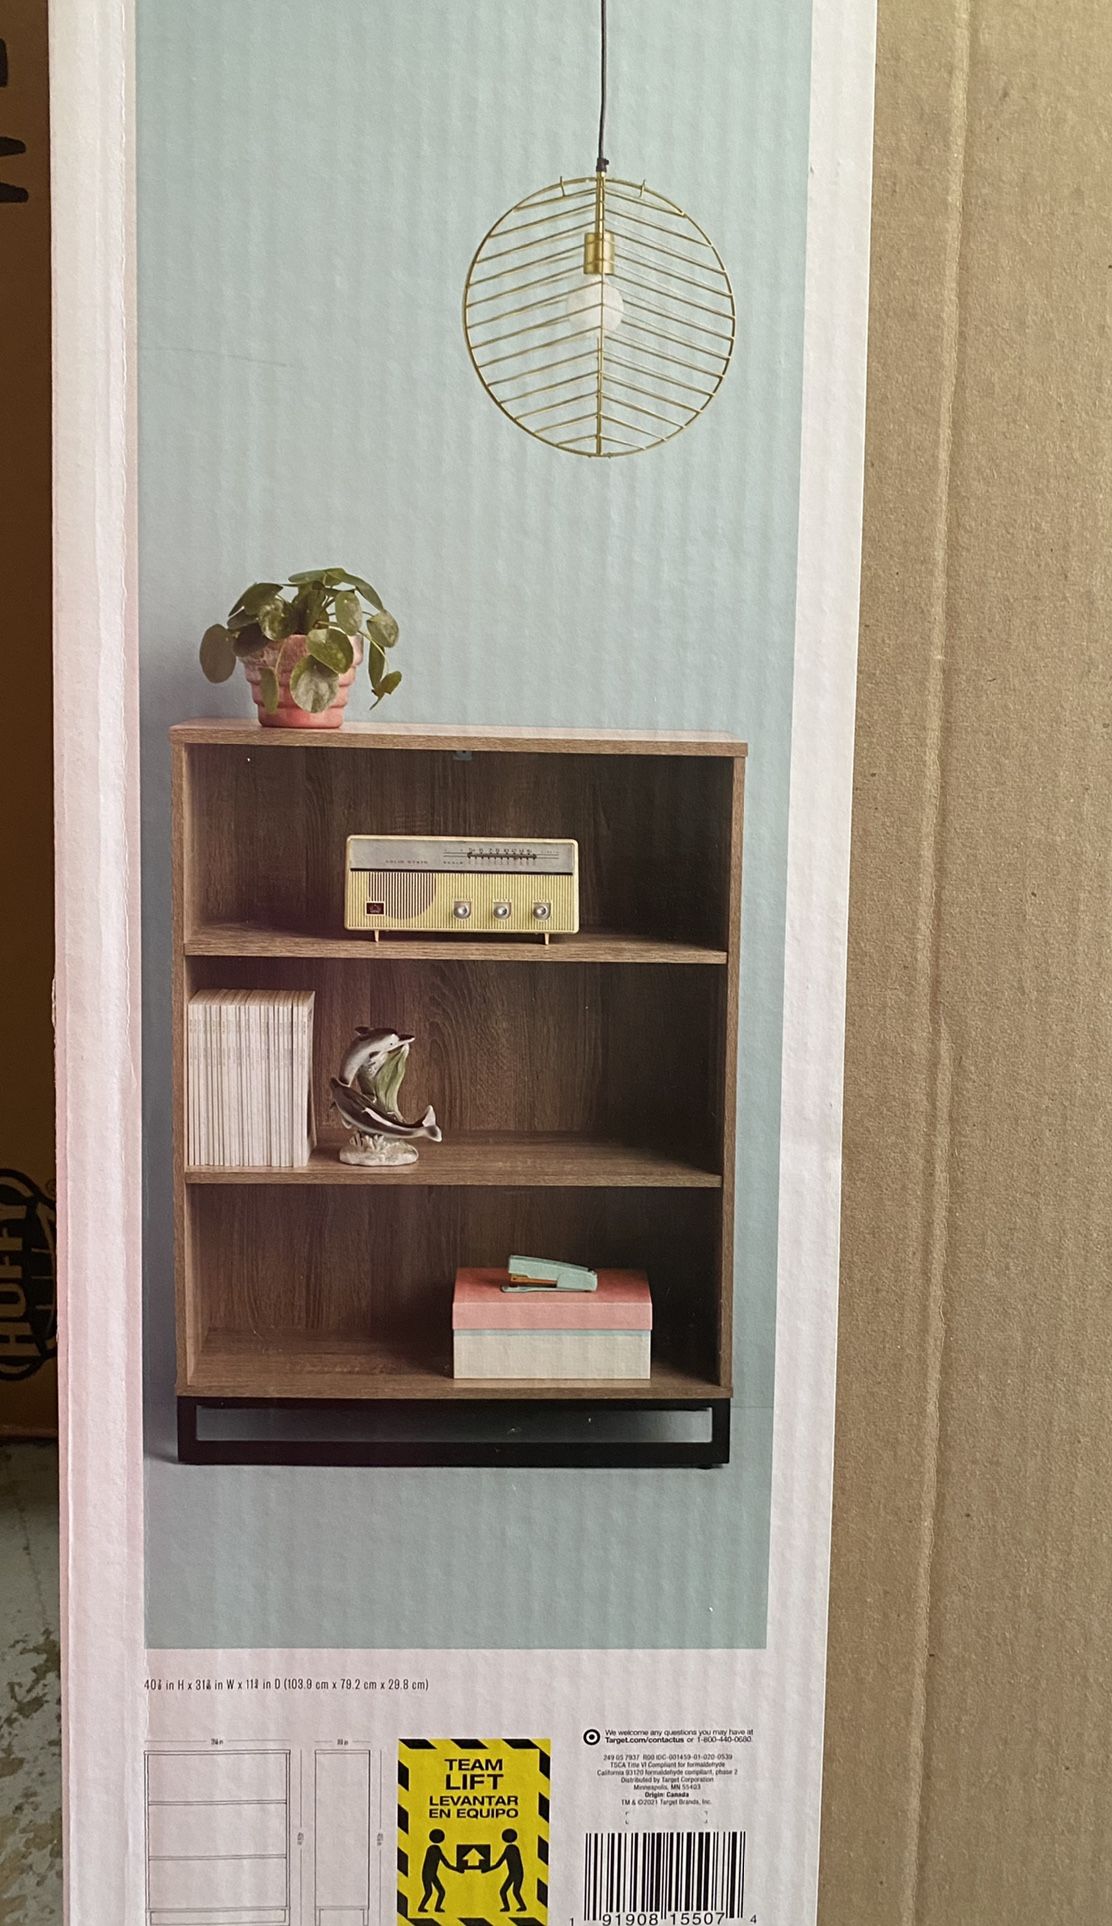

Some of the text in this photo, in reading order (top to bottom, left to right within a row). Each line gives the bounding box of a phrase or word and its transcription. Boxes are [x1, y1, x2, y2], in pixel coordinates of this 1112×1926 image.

[165, 1679, 175, 1690] in
[177, 1679, 184, 1690] H
[214, 1679, 223, 1690] in
[226, 1679, 234, 1690] W
[237, 1682, 242, 1690] x
[262, 1679, 272, 1690] in
[274, 1679, 281, 1690] D
[283, 1679, 312, 1691] (103.9
[315, 1682, 328, 1690] cm
[332, 1682, 338, 1690] x
[340, 1679, 360, 1690] 79.2
[363, 1682, 378, 1690] cm
[380, 1682, 386, 1690] x
[388, 1679, 409, 1690] 29.8
[412, 1679, 429, 1691] cm)
[445, 1759, 503, 1771] TEAM
[446, 1774, 504, 1790] LIFT
[429, 1796, 518, 1806] LEVANTAR
[429, 1808, 518, 1819] EN EQUIPO
[602, 1913, 658, 1926] 91908
[671, 1912, 724, 1925] 15507
[750, 1914, 757, 1924] 4
